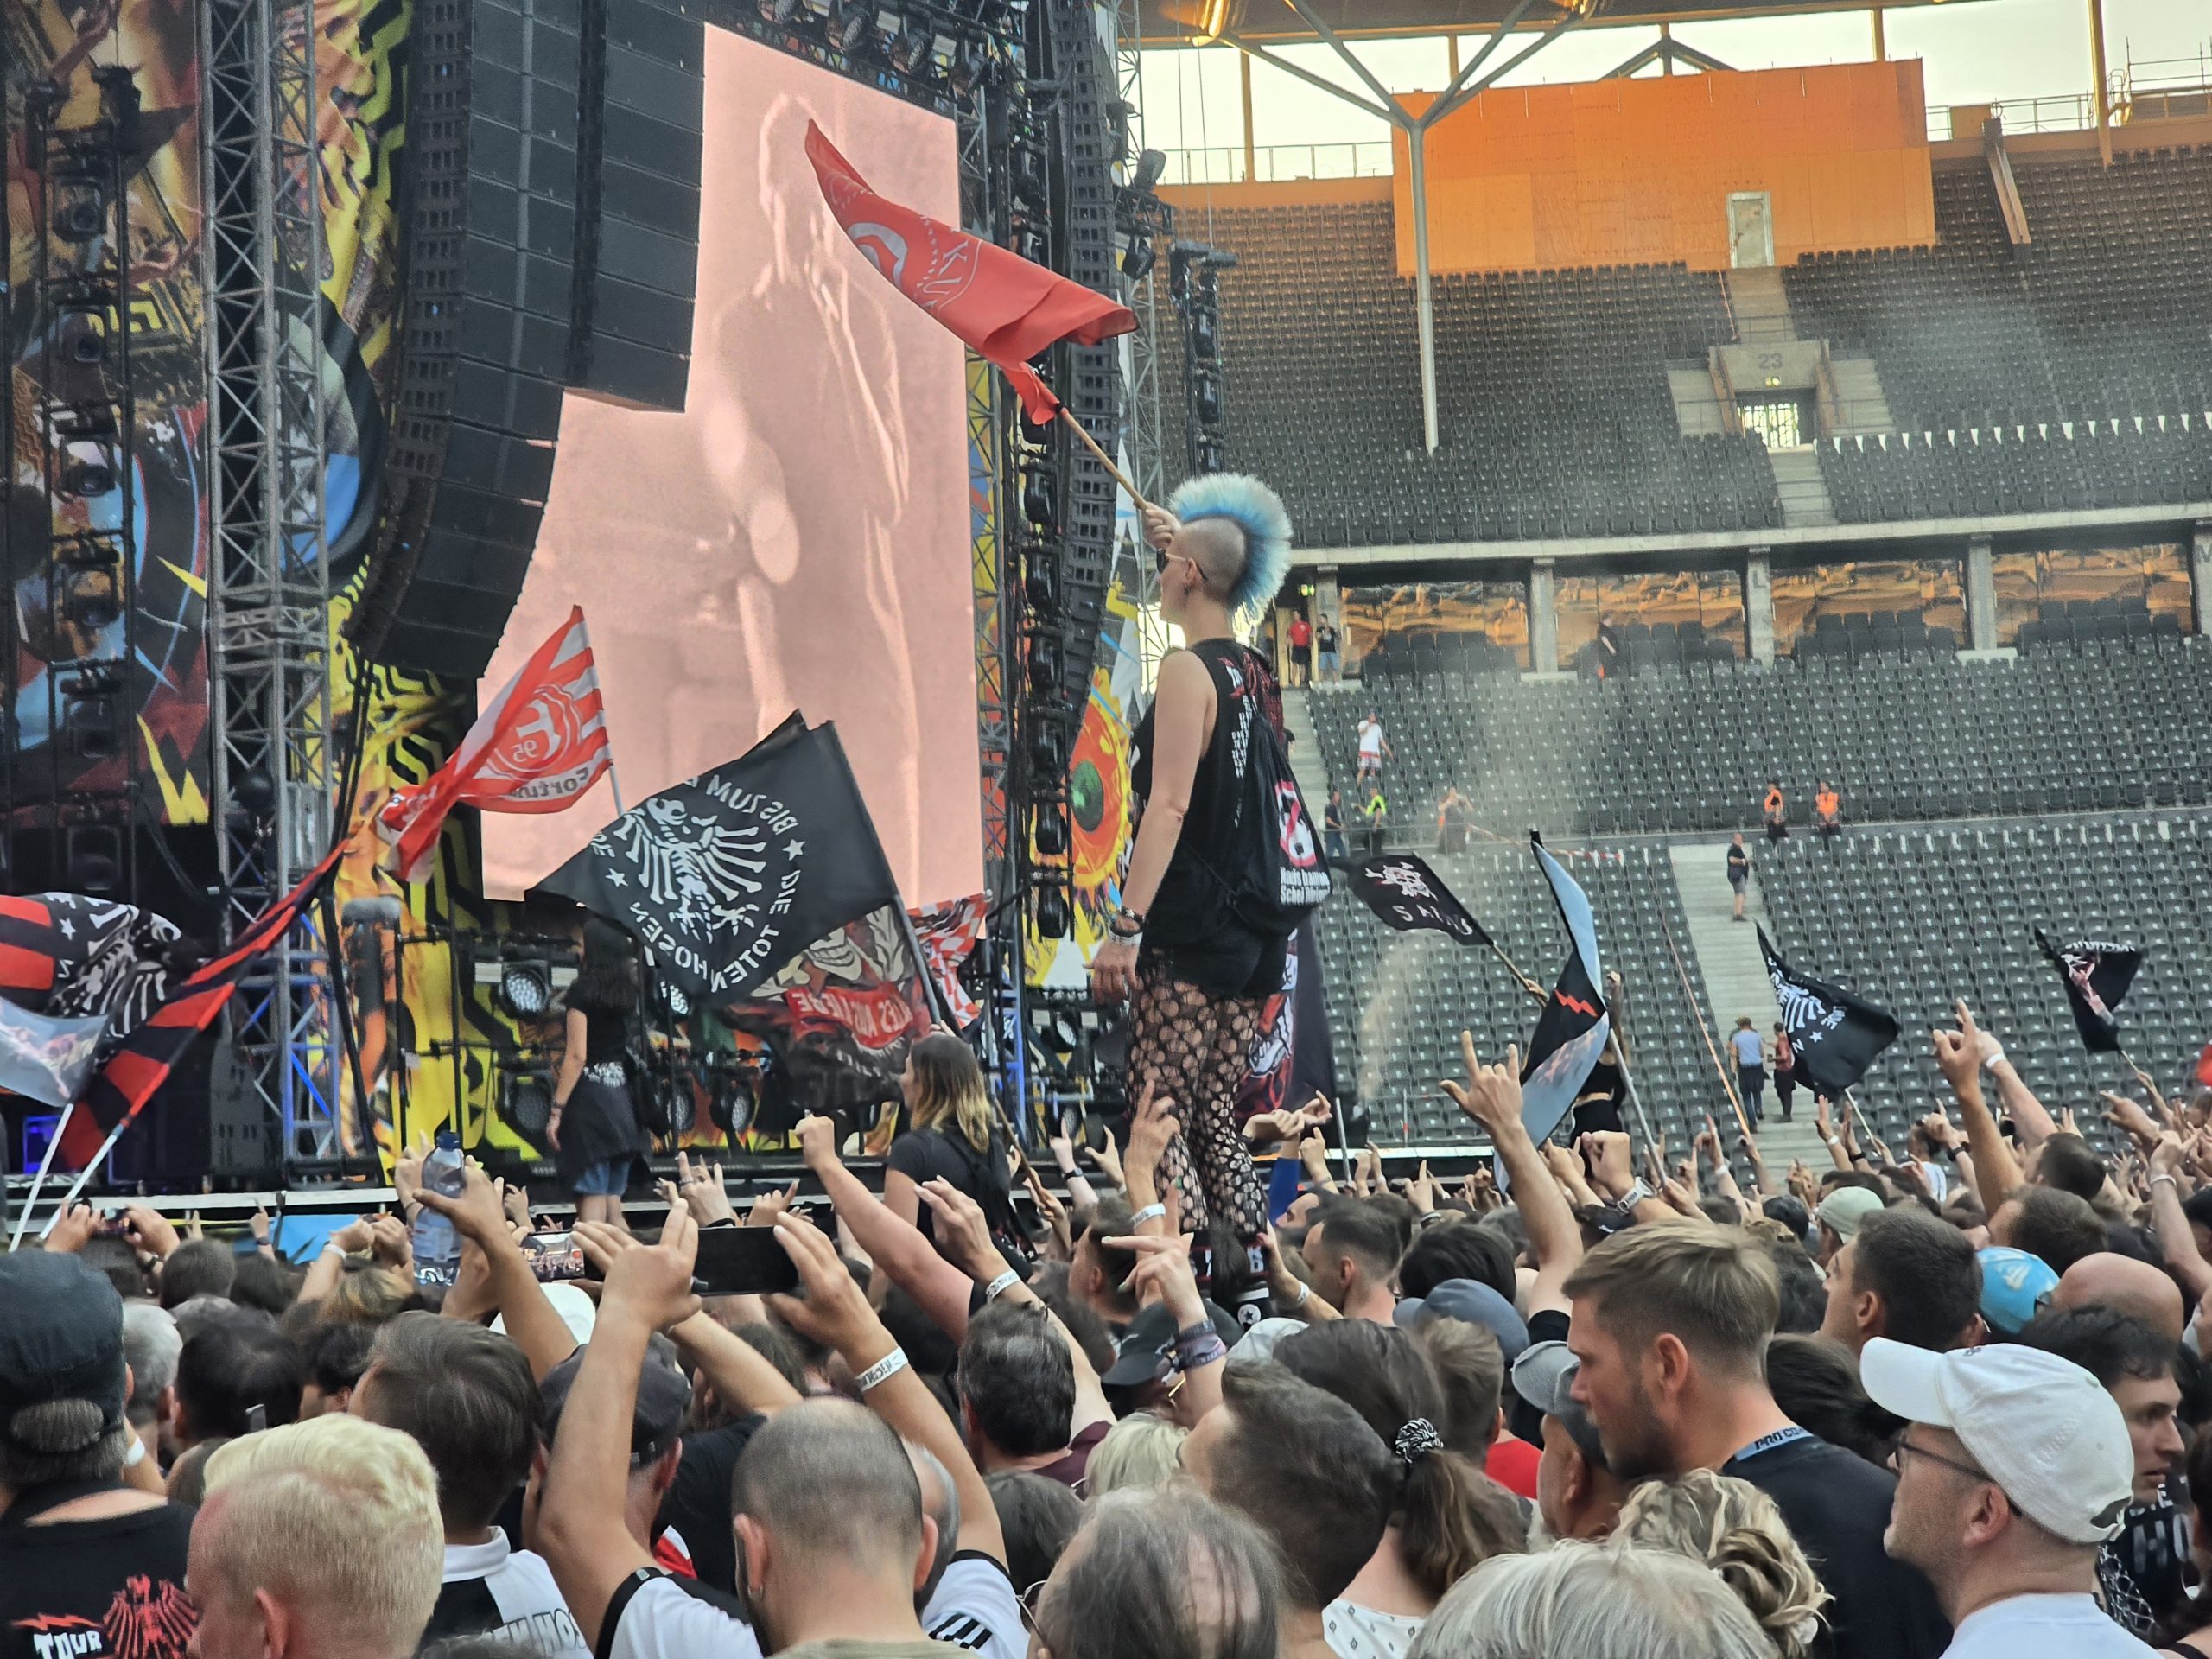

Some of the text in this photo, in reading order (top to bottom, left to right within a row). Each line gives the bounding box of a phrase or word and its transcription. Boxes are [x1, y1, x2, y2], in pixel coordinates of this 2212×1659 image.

[1758, 353, 1783, 370] 23
[1754, 1432, 1783, 1451] PRO
[33, 1630, 103, 1659] TOUR
